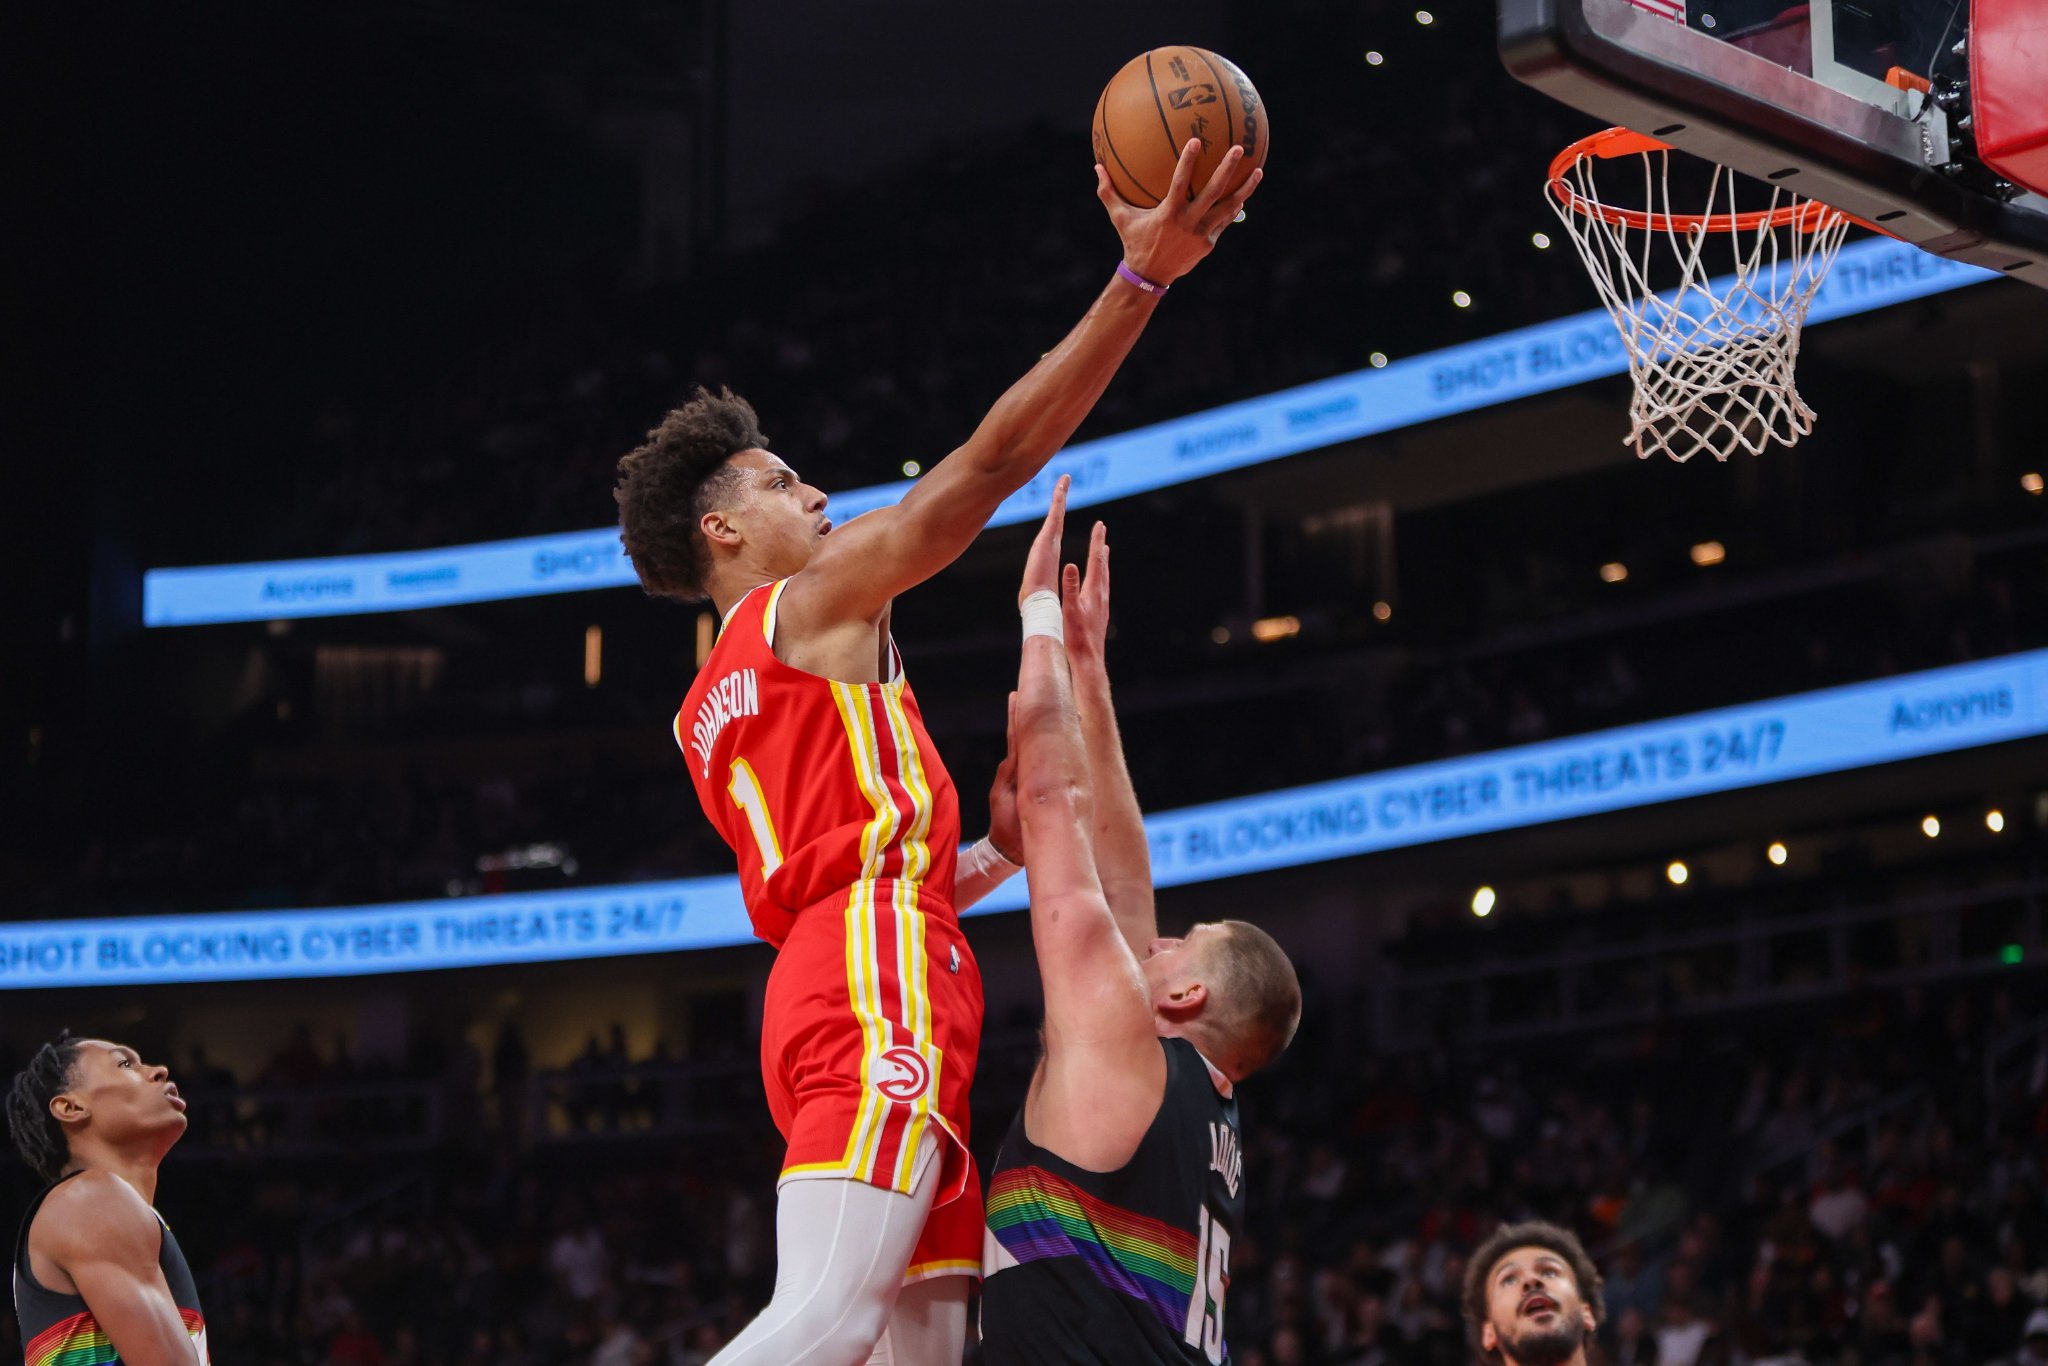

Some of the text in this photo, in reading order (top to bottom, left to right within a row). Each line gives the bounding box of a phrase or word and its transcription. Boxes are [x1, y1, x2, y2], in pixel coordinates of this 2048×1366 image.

[1432, 349, 1518, 399] SHOT
[1837, 249, 1957, 296] THRE
[691, 668, 759, 779] JOHNSON
[1888, 683, 2014, 735] Acronis
[727, 756, 784, 883] 1
[1185, 797, 1367, 865] BLOCKING
[1378, 775, 1500, 830] CYBER
[1512, 737, 1691, 801] THREATS
[1703, 718, 1786, 773] 24/7
[97, 925, 291, 970] BLOCKING
[302, 921, 419, 961] CYBER
[434, 907, 596, 949] THREATS
[607, 898, 686, 938] 24/7
[1185, 1203, 1231, 1365] 15
